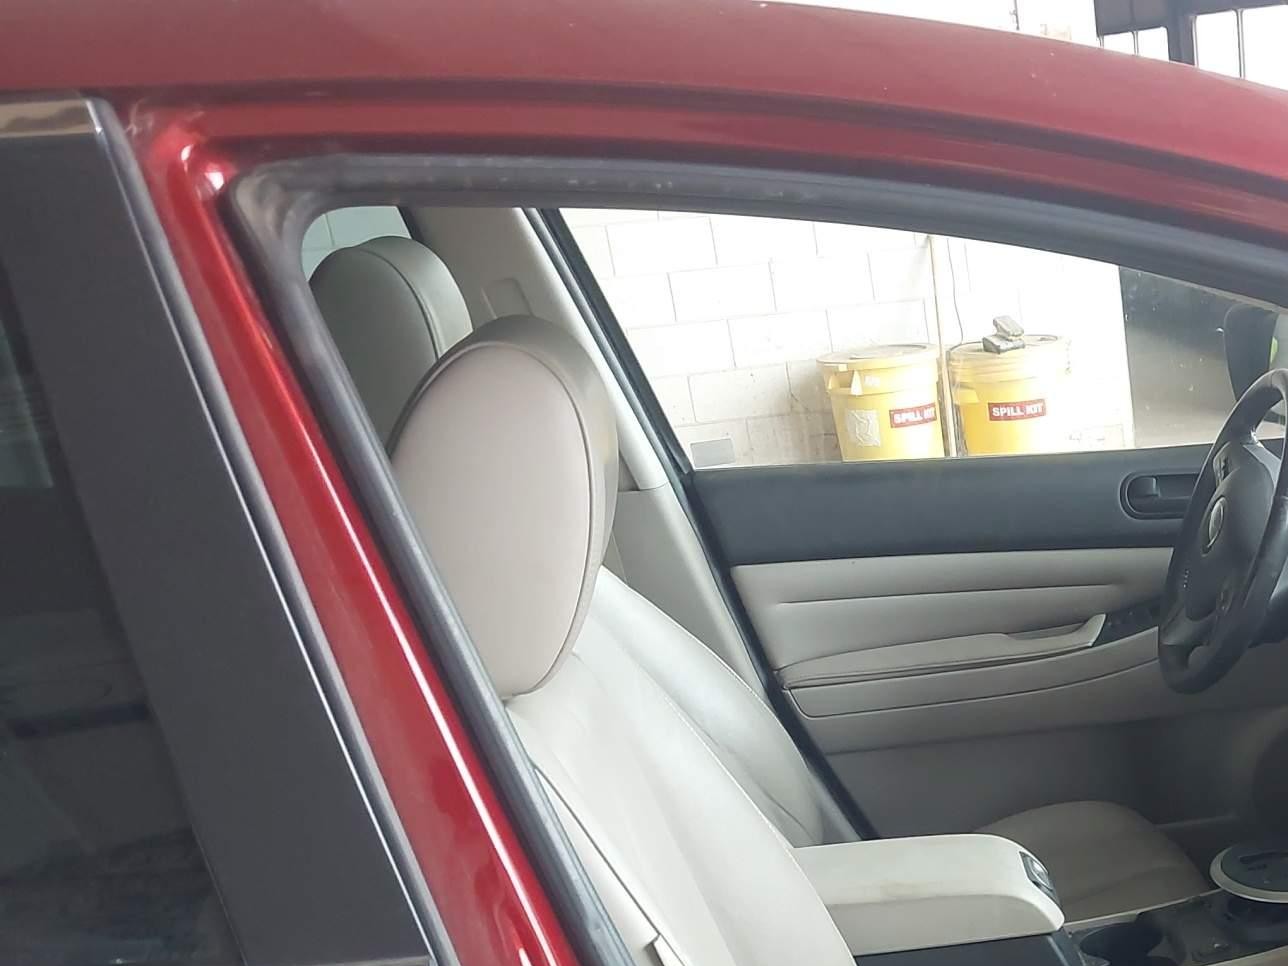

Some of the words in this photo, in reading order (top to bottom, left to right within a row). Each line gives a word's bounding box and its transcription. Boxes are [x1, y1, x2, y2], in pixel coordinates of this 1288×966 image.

[992, 405, 1025, 417] SPILL
[1025, 403, 1045, 414] KIT
[893, 411, 923, 424] SPILL
